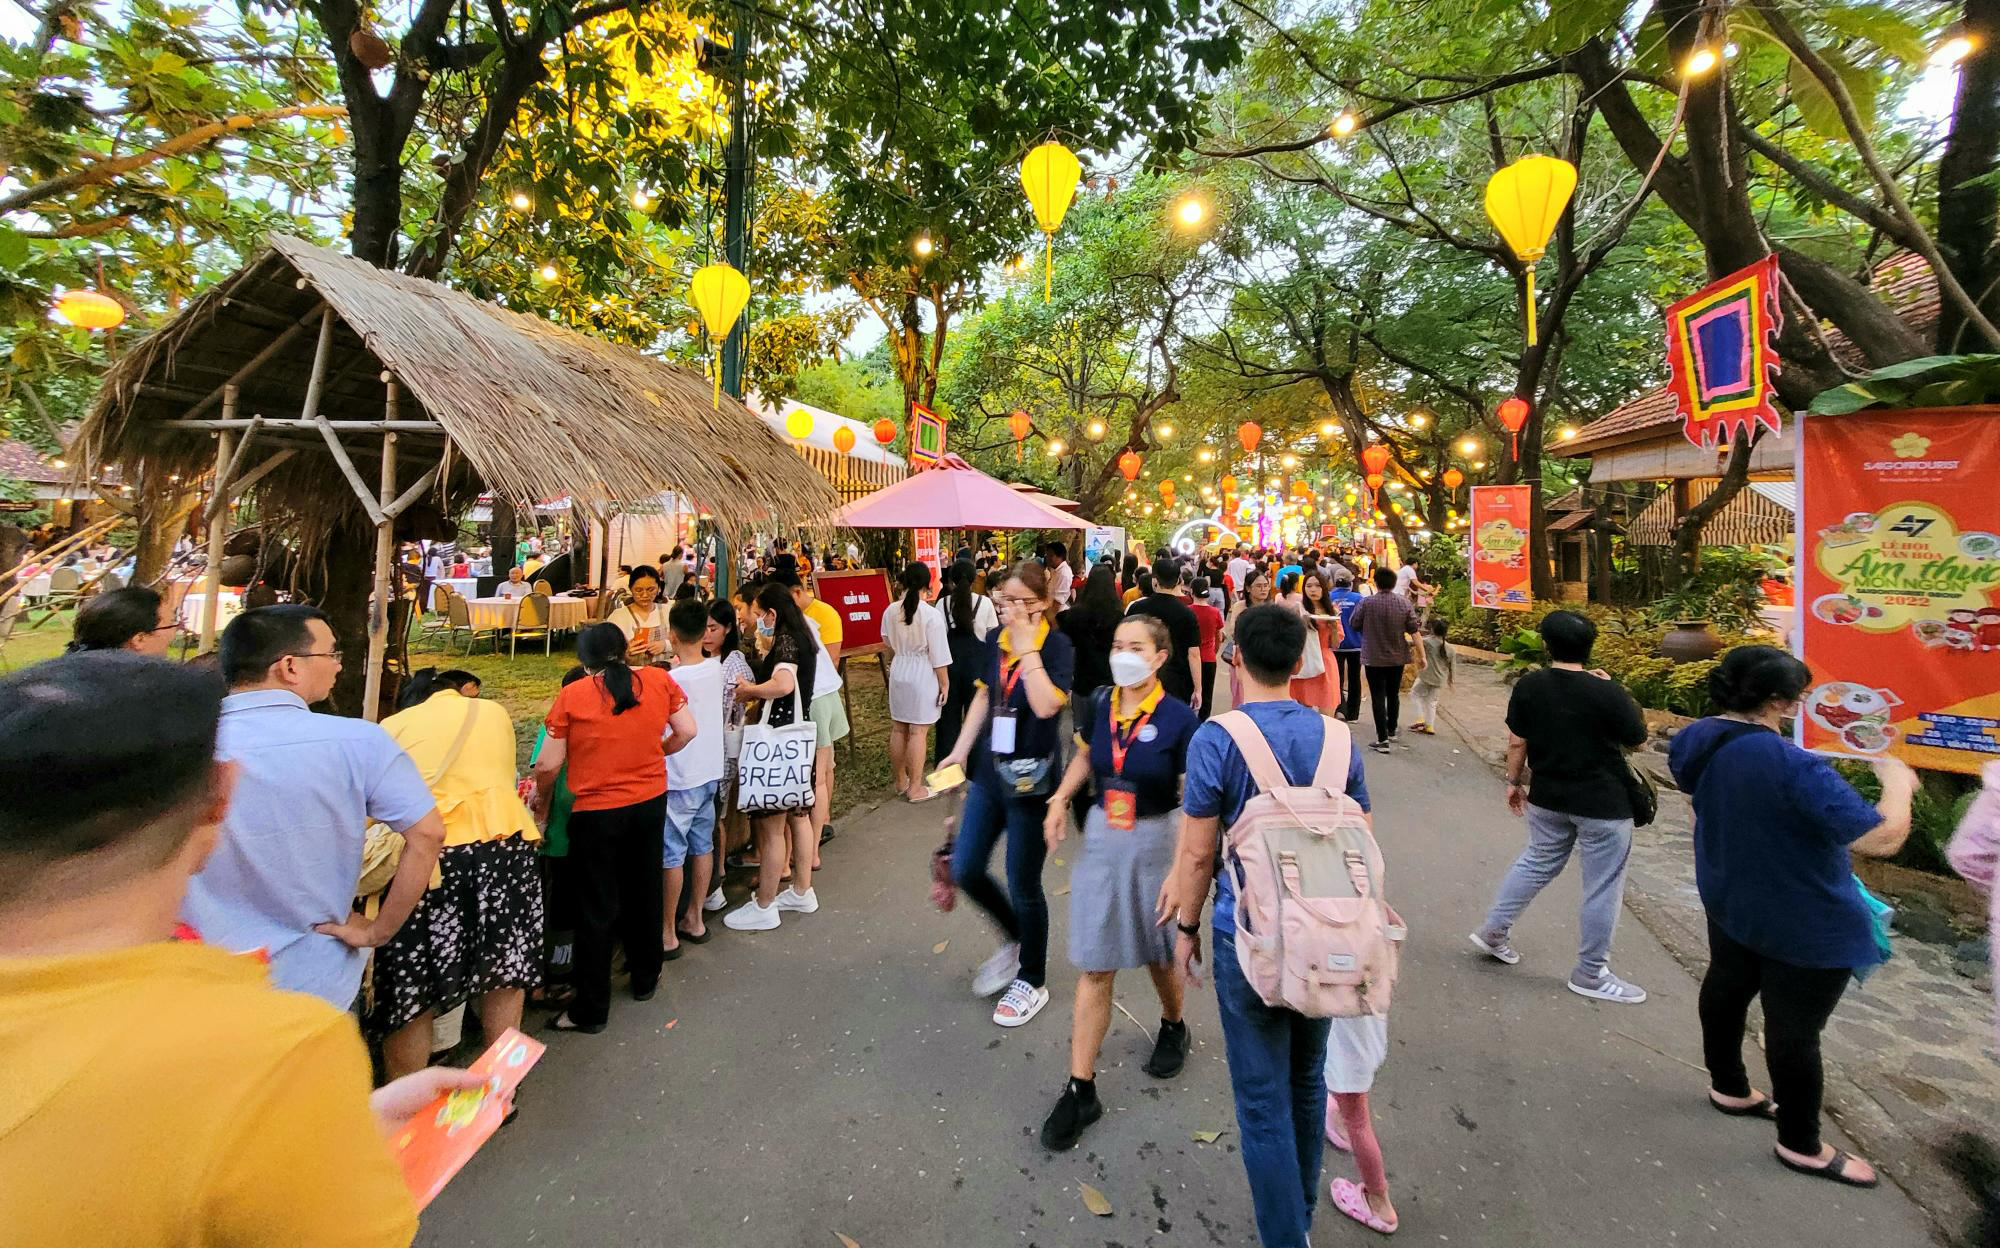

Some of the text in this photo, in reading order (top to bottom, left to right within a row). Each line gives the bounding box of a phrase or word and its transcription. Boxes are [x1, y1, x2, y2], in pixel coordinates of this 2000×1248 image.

[1884, 595, 1930, 608] 2022
[745, 740, 815, 762] TOAST
[741, 789, 814, 810] ARGE
